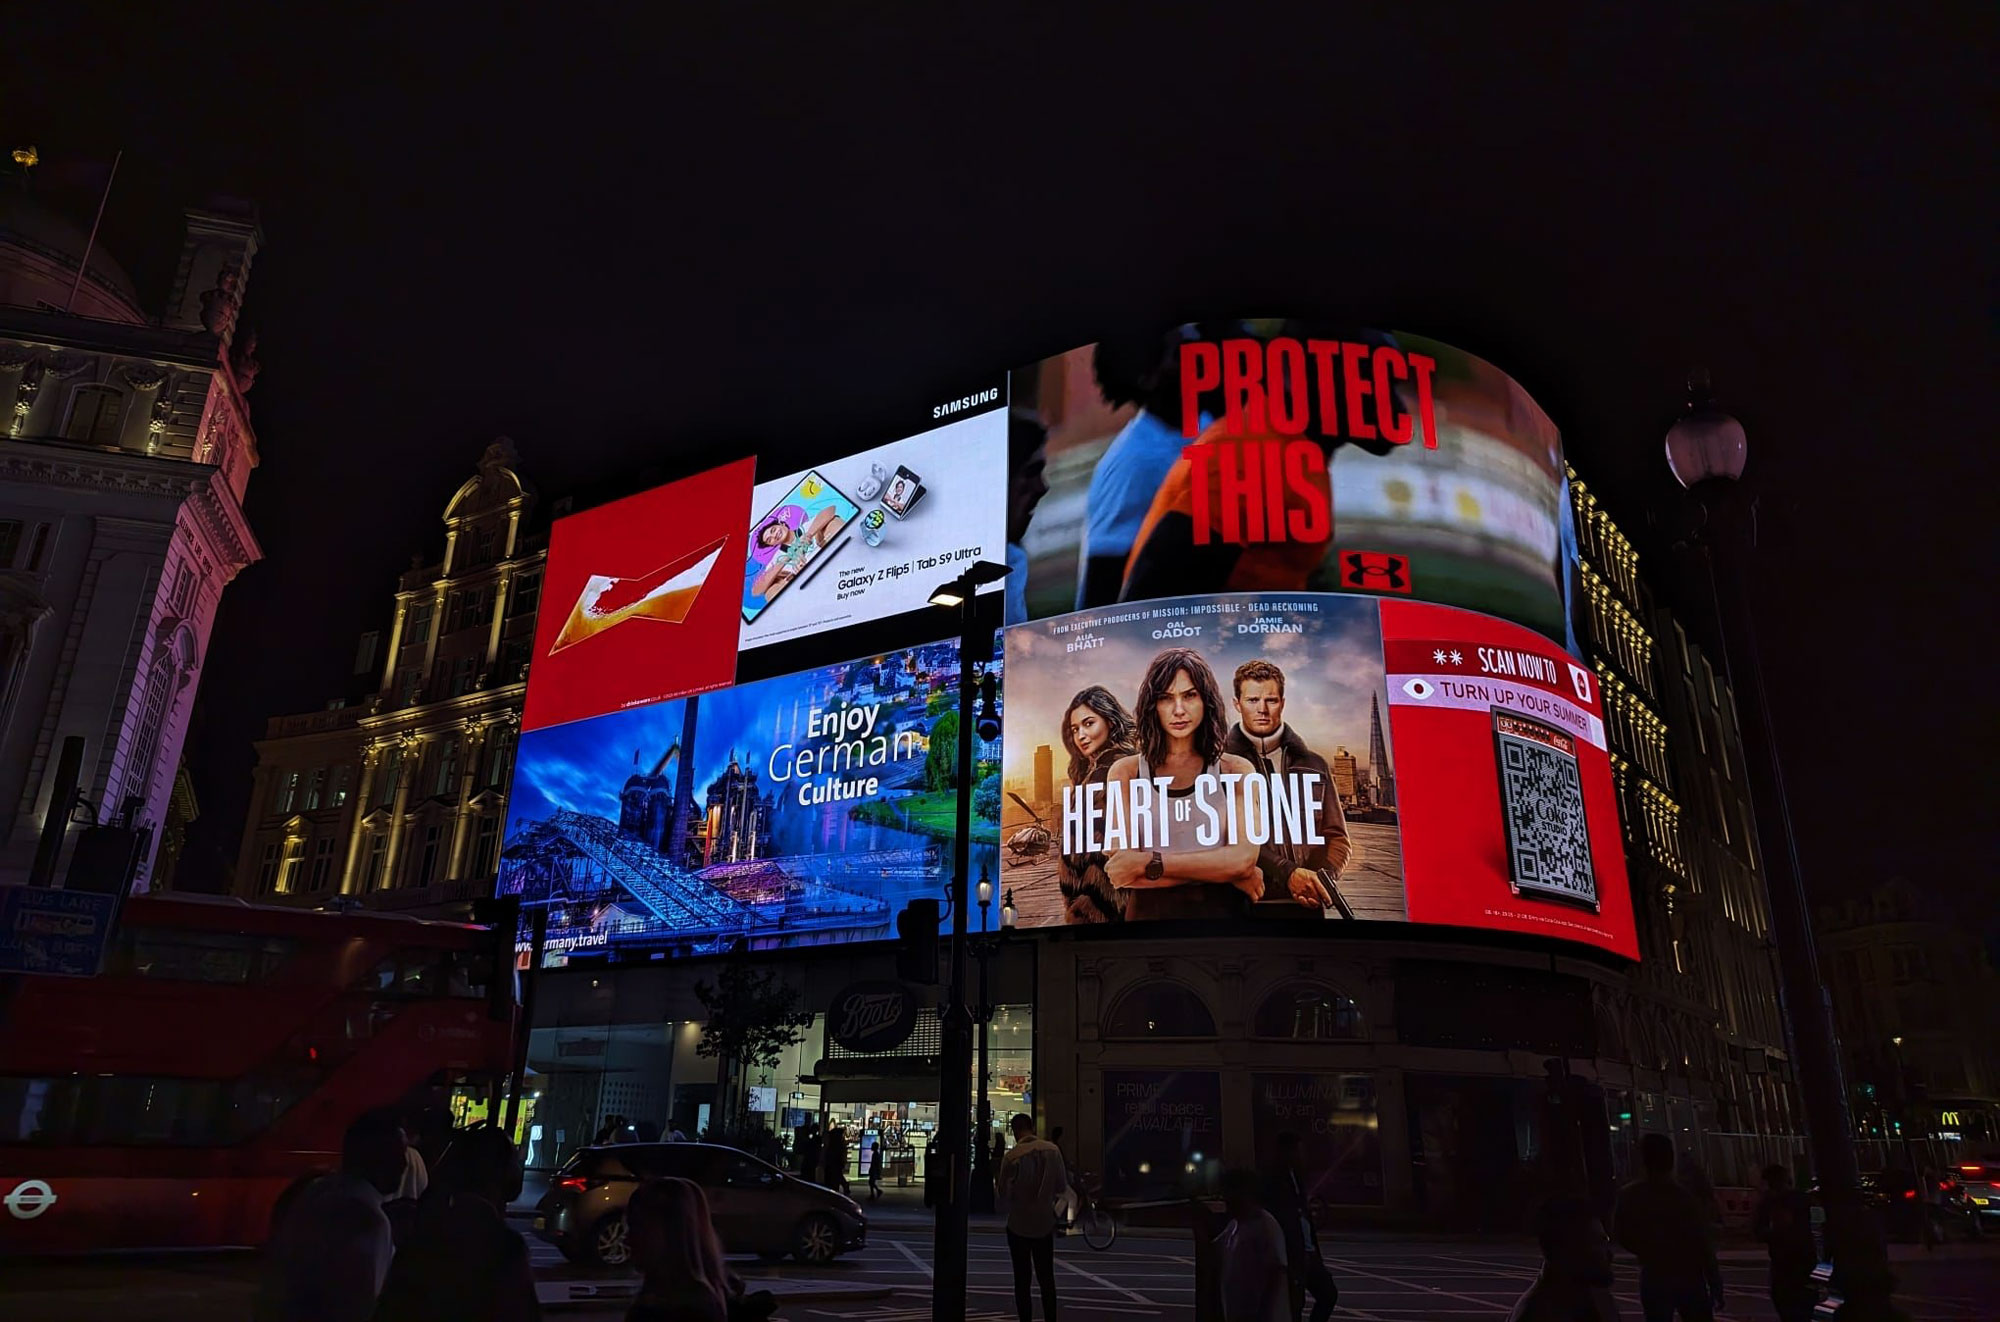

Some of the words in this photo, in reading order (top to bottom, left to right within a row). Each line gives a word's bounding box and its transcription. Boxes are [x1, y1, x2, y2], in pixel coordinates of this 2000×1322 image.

[932, 387, 999, 419] SAMSUNG
[1180, 337, 1438, 449] PROTECT
[1182, 439, 1331, 545] THIS
[838, 572, 876, 591] Galaxy
[878, 570, 885, 581] Z
[886, 562, 910, 580] Flip5
[917, 557, 937, 571] Tab
[939, 552, 953, 566] S9
[954, 546, 982, 562] Ultra
[838, 570, 850, 578] The
[851, 566, 866, 576] new
[837, 591, 850, 601] Buy
[850, 587, 866, 598] now
[1053, 625, 1069, 635] FROM
[1070, 618, 1102, 632] EXECUTIVE
[1103, 612, 1140, 625] PRODUCERS
[1142, 611, 1150, 620] OF
[1152, 606, 1189, 618] MISSION:
[1190, 603, 1240, 615] IMPOSSIBLE
[1248, 602, 1270, 612] DEAD
[1272, 602, 1319, 612] RECKONING
[1152, 626, 1202, 640] GADOT
[1166, 621, 1185, 629] GAL
[1238, 624, 1303, 634] DORNAN
[1066, 637, 1105, 653] BHATT
[1075, 633, 1094, 642] ALIA
[1478, 647, 1515, 674] SCAN
[1516, 652, 1544, 681] NOW
[1543, 658, 1557, 684] TO
[807, 701, 881, 743] Enjoy
[1440, 681, 1489, 701] TURN
[1494, 688, 1515, 705] UP
[1517, 693, 1551, 715] YOUR
[1552, 703, 1587, 731] SUMMER
[769, 731, 913, 783] German
[798, 776, 879, 806] Culture
[1062, 776, 1175, 856] HEART
[1175, 799, 1191, 822] OF
[1194, 773, 1326, 847] STONE
[1536, 799, 1568, 827] Coke
[1541, 821, 1568, 836] STUDIO
[840, 992, 903, 1039] Boots
